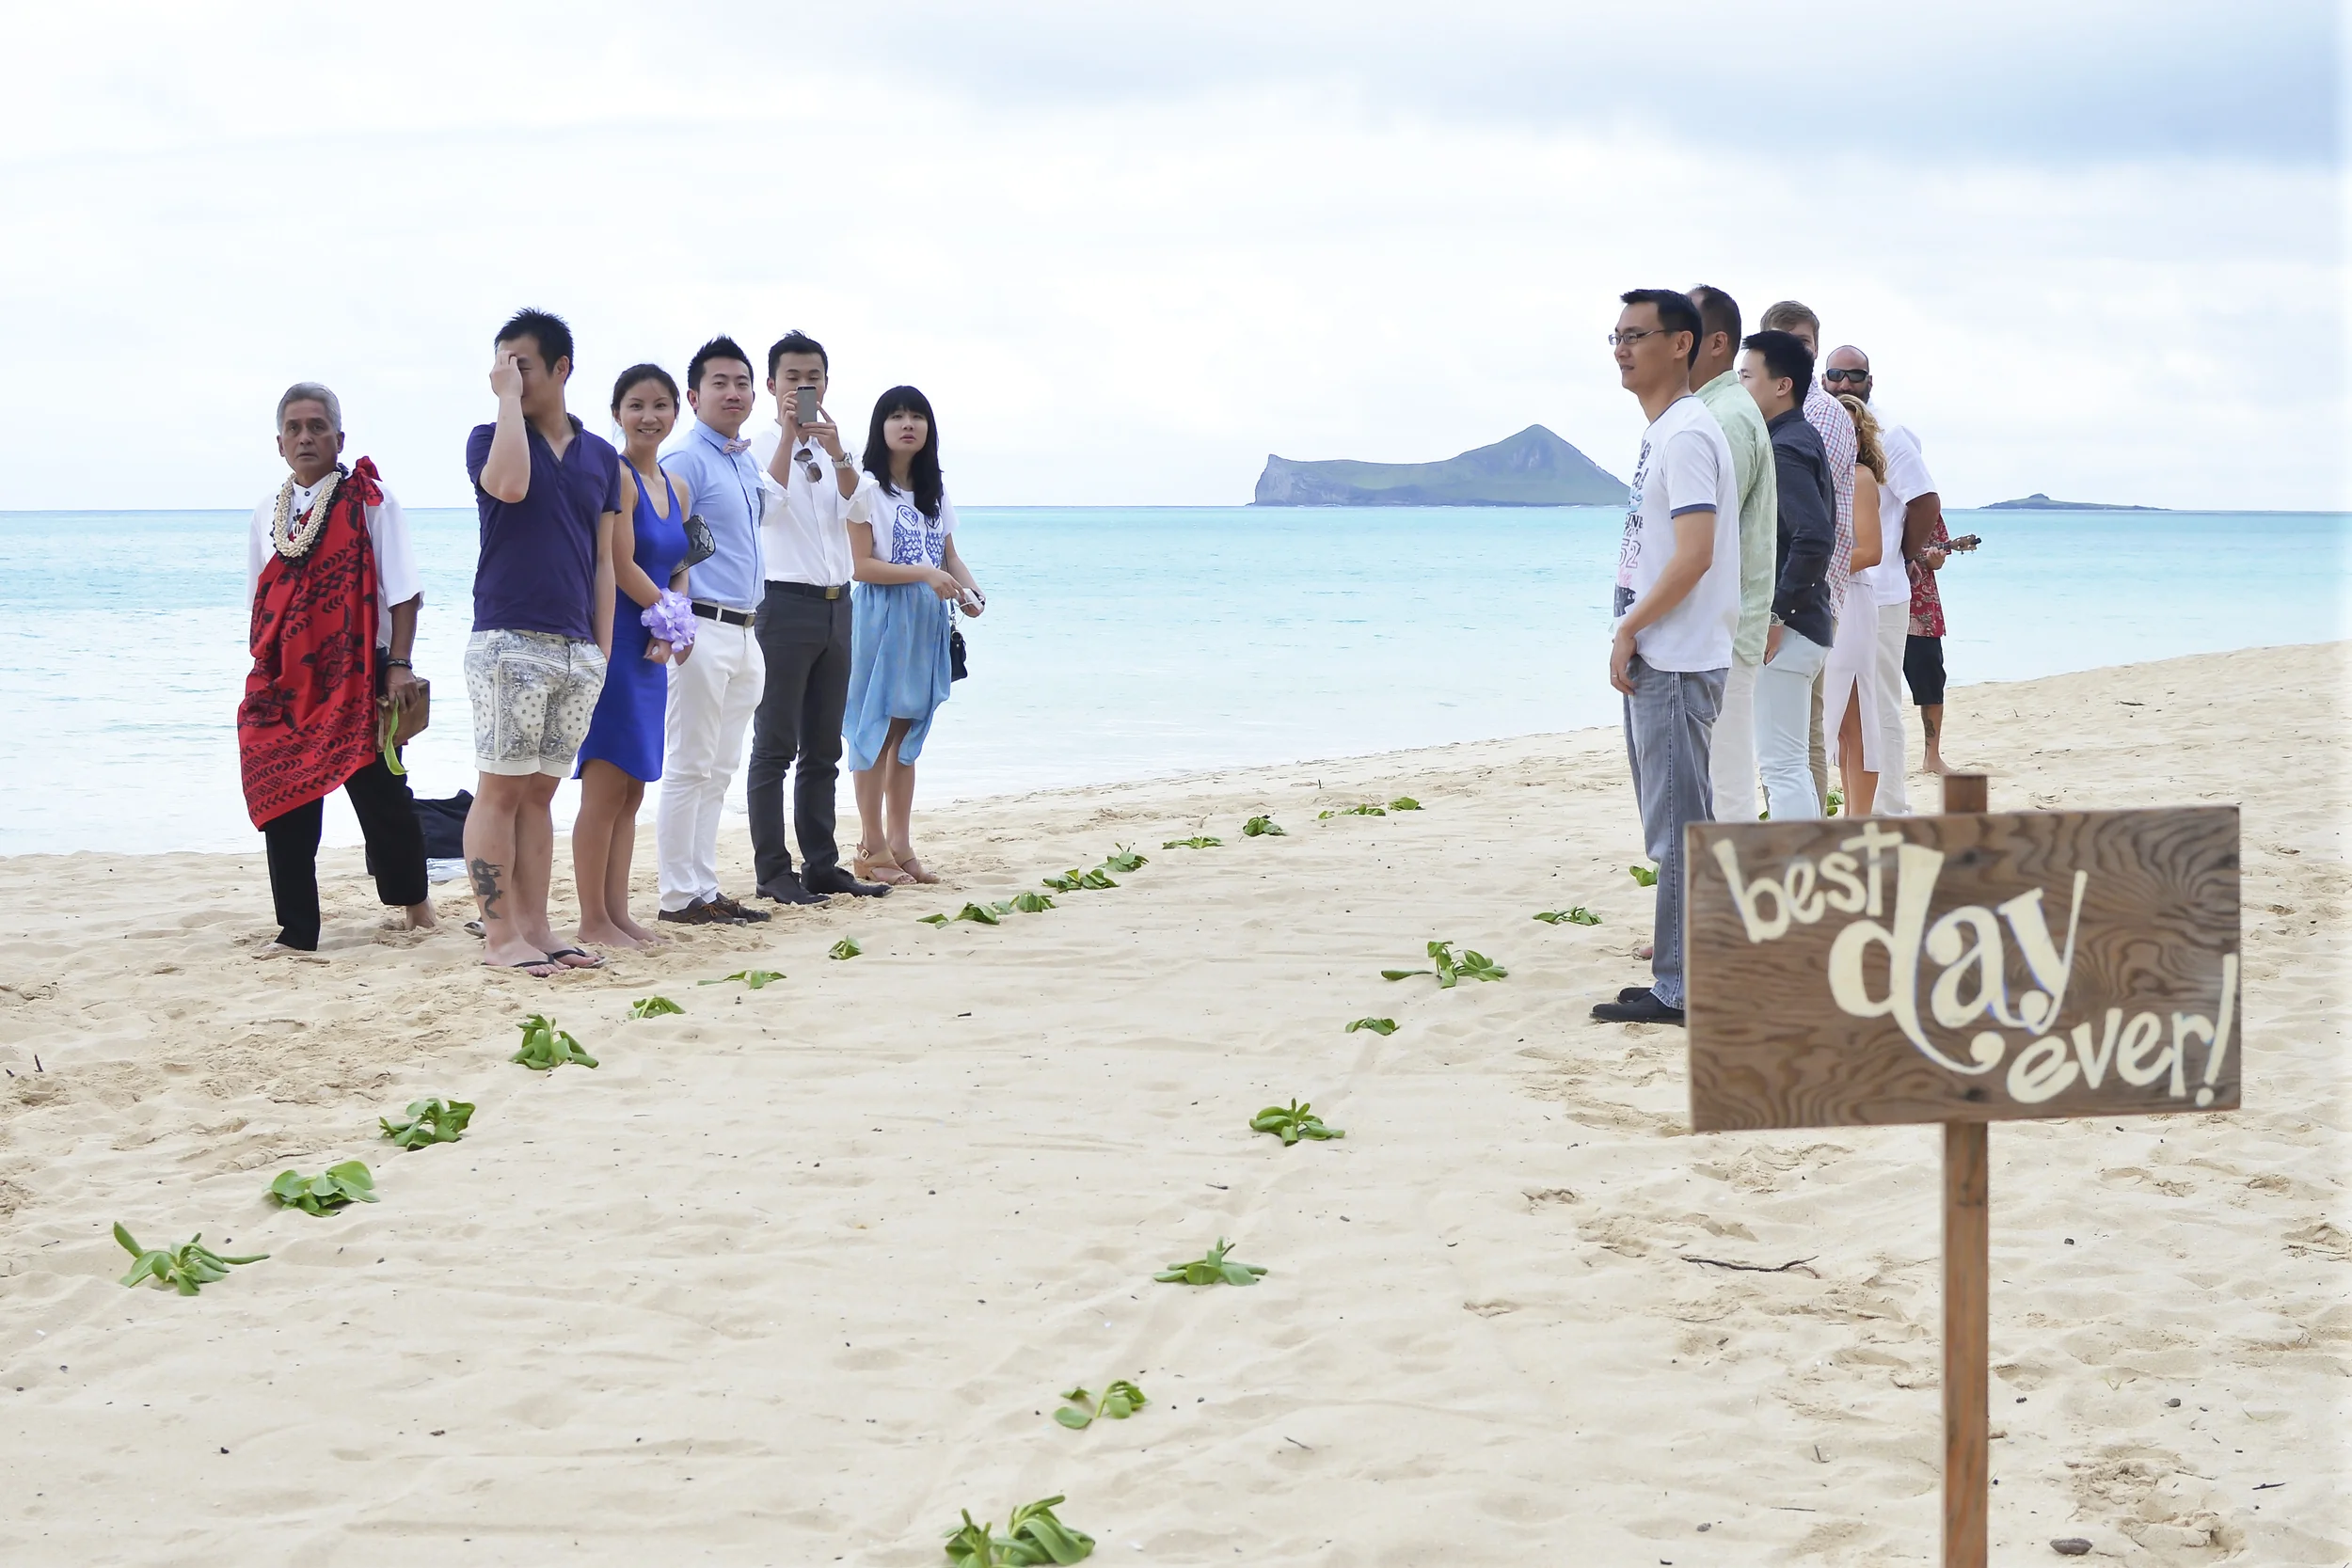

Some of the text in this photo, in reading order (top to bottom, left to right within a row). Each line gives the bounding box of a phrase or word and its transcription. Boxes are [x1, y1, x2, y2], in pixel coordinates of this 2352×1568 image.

[1713, 822, 1903, 942] best
[1829, 844, 2088, 1075] day
[2007, 954, 2236, 1107] ever!
